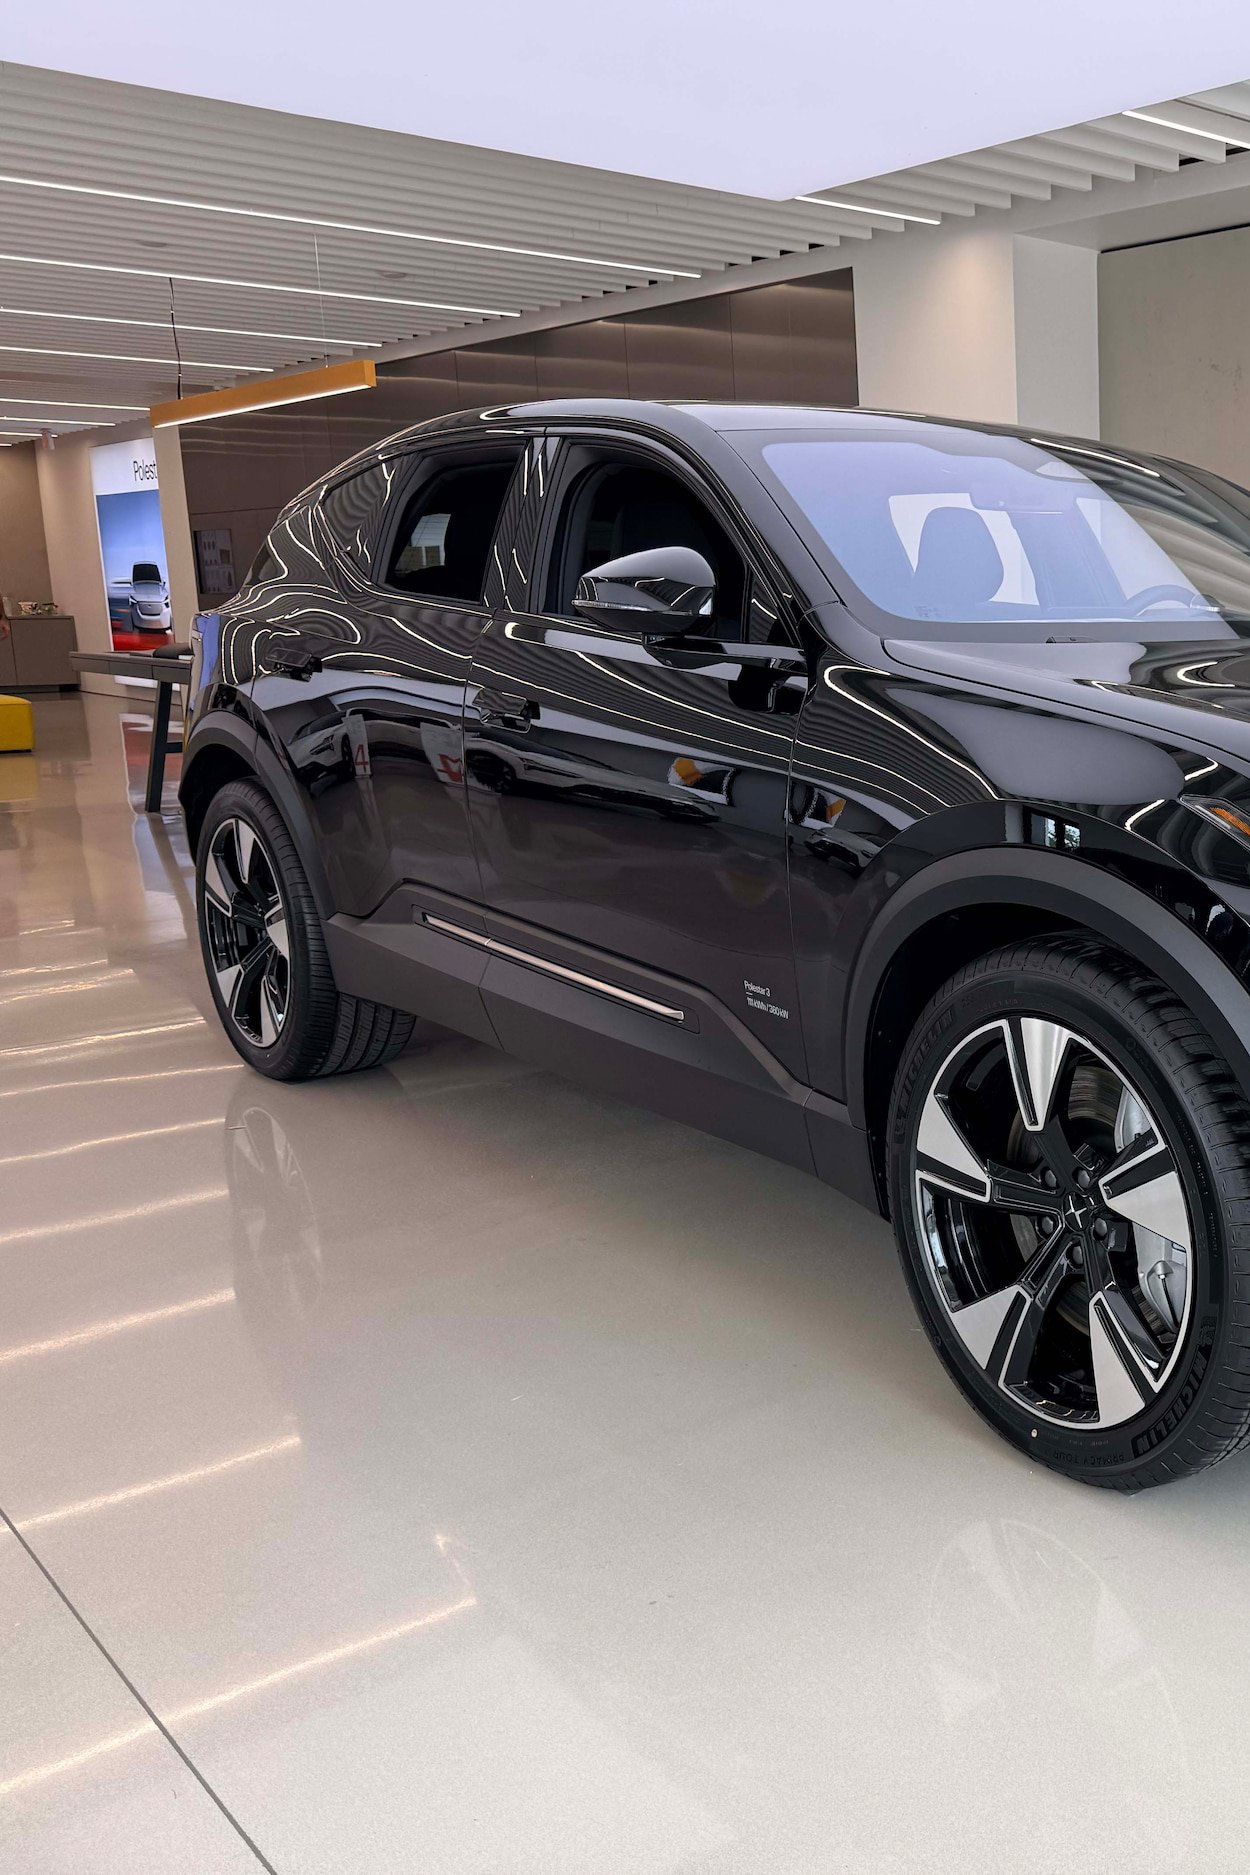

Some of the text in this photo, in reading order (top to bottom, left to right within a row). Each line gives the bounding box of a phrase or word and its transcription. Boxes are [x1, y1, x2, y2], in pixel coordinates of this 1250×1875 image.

[744, 980, 770, 997] Polestar 3
[899, 1008, 954, 1112] MICHELIN
[1136, 1352, 1208, 1455] MICHELIN
